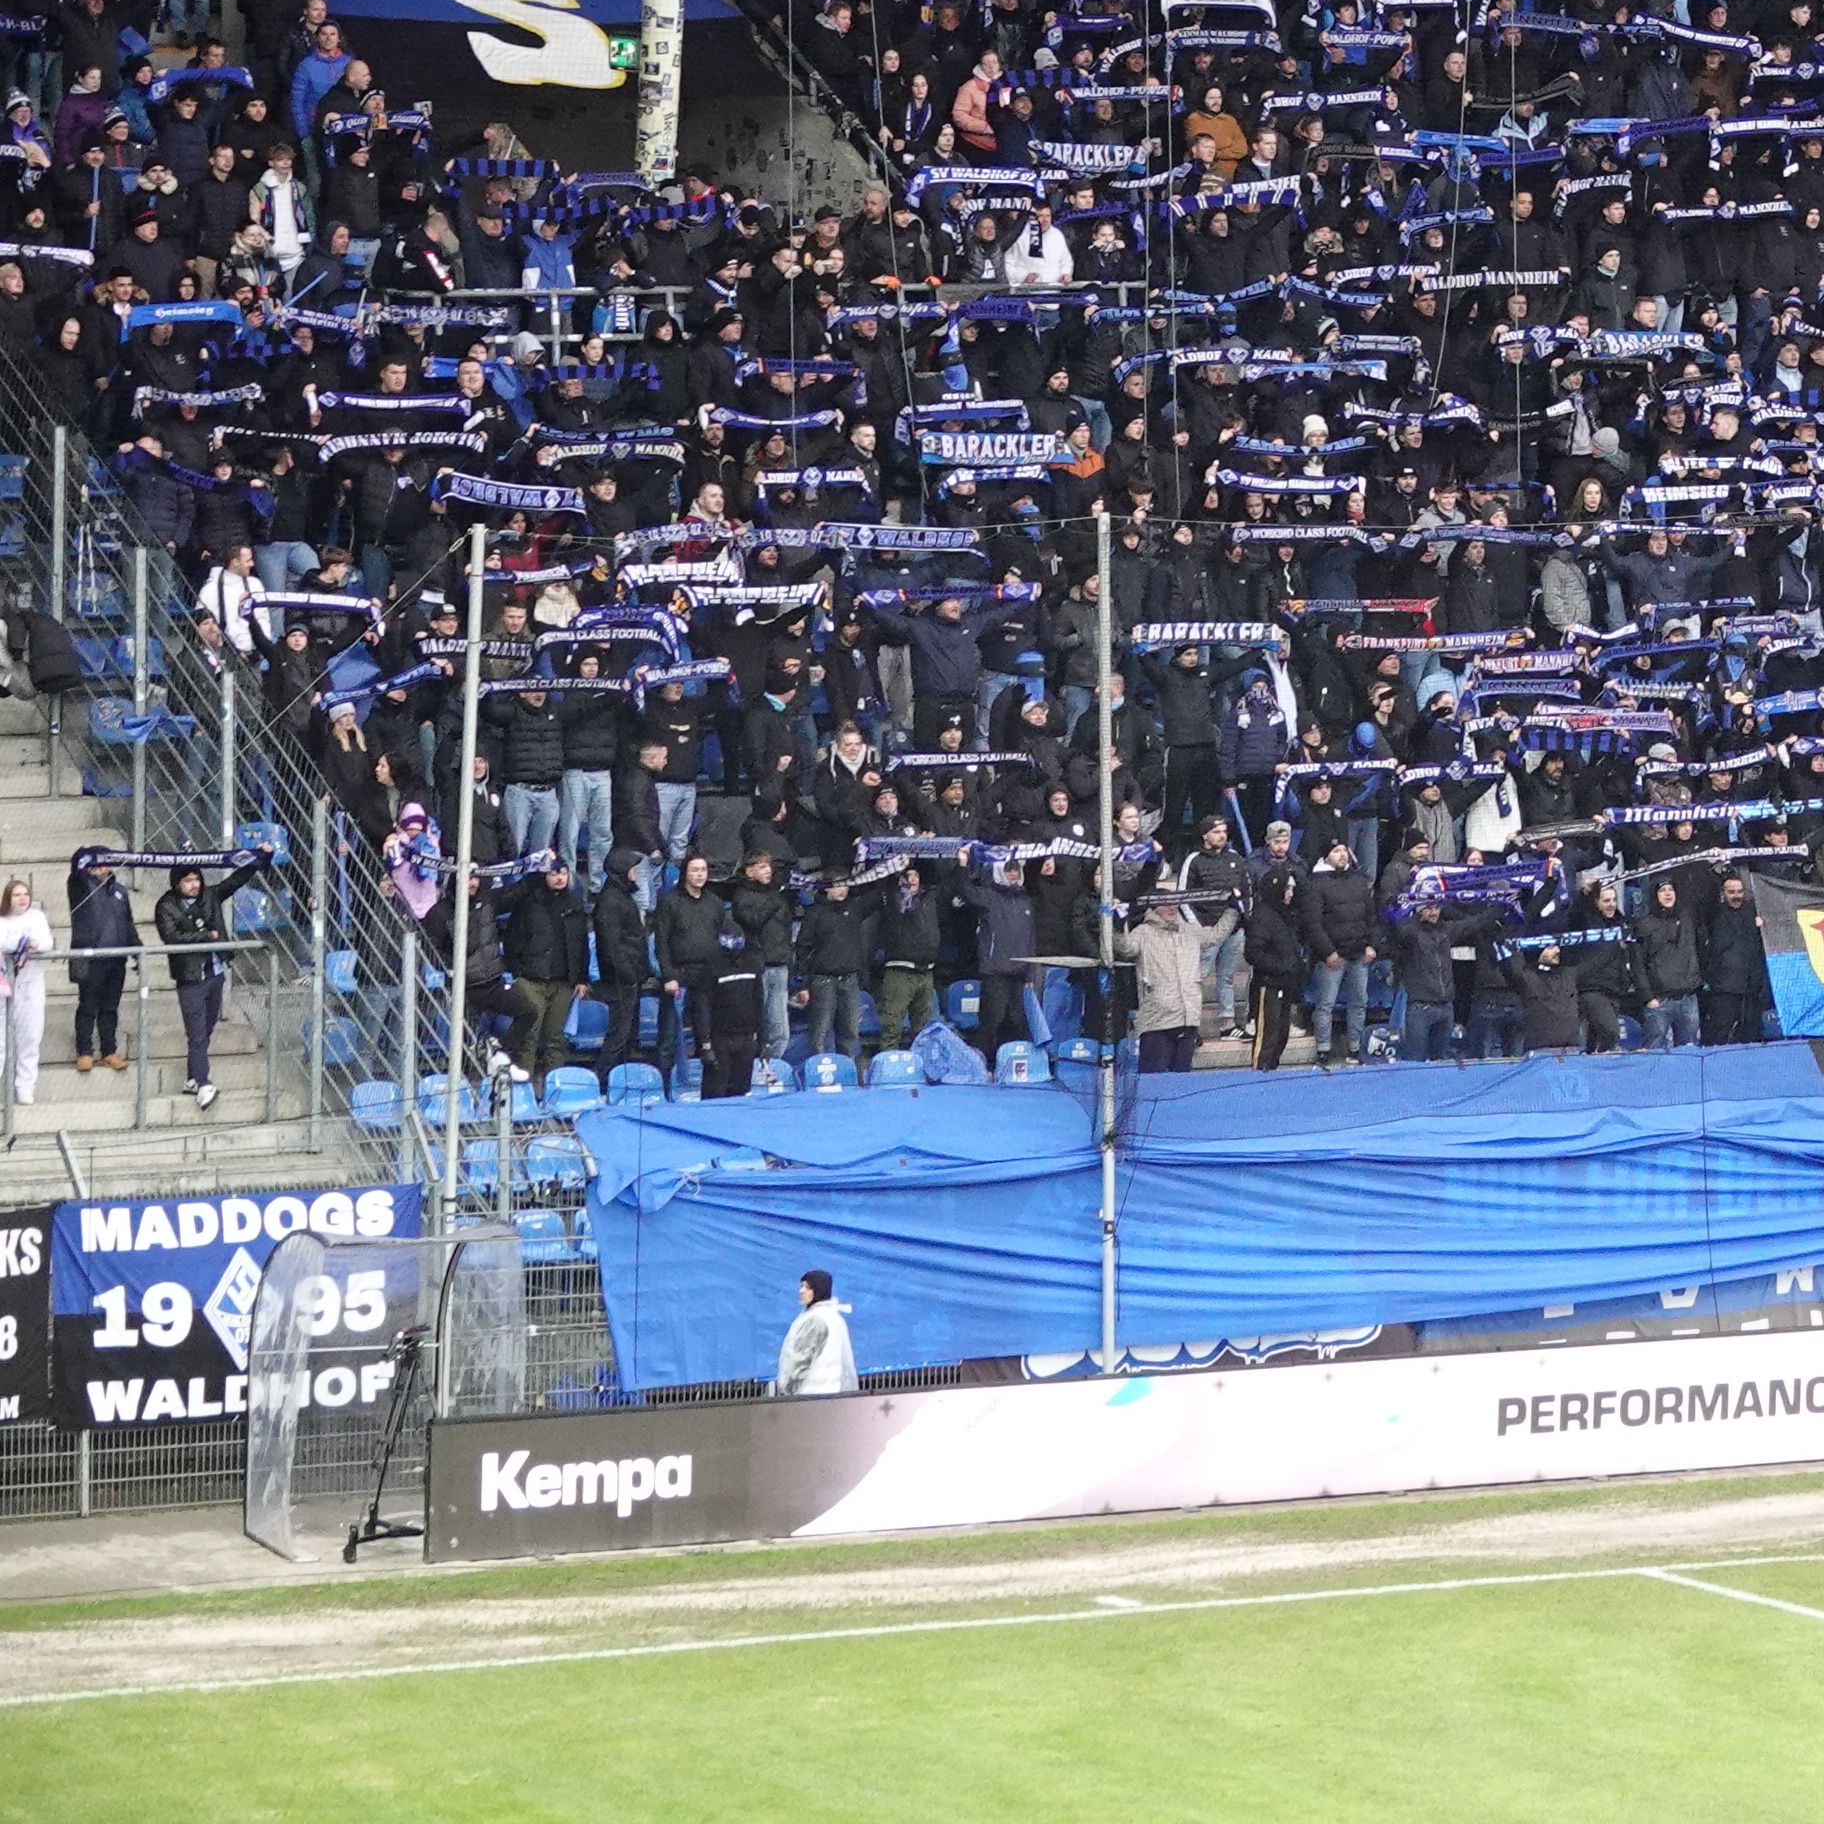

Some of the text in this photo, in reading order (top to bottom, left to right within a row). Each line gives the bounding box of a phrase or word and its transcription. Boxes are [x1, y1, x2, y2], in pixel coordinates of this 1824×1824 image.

[929, 167, 946, 179] SV
[1485, 271, 1560, 286] MANNHEIM
[942, 434, 1056, 457] BARACKLER
[1642, 485, 1730, 501] HEIMSIEG
[1363, 635, 1427, 649] FRANKFURT
[80, 1189, 395, 1253] MADDOGS
[93, 1270, 387, 1348] 19 95
[85, 1360, 396, 1422] WALDHOF
[481, 1451, 693, 1518] Kempa
